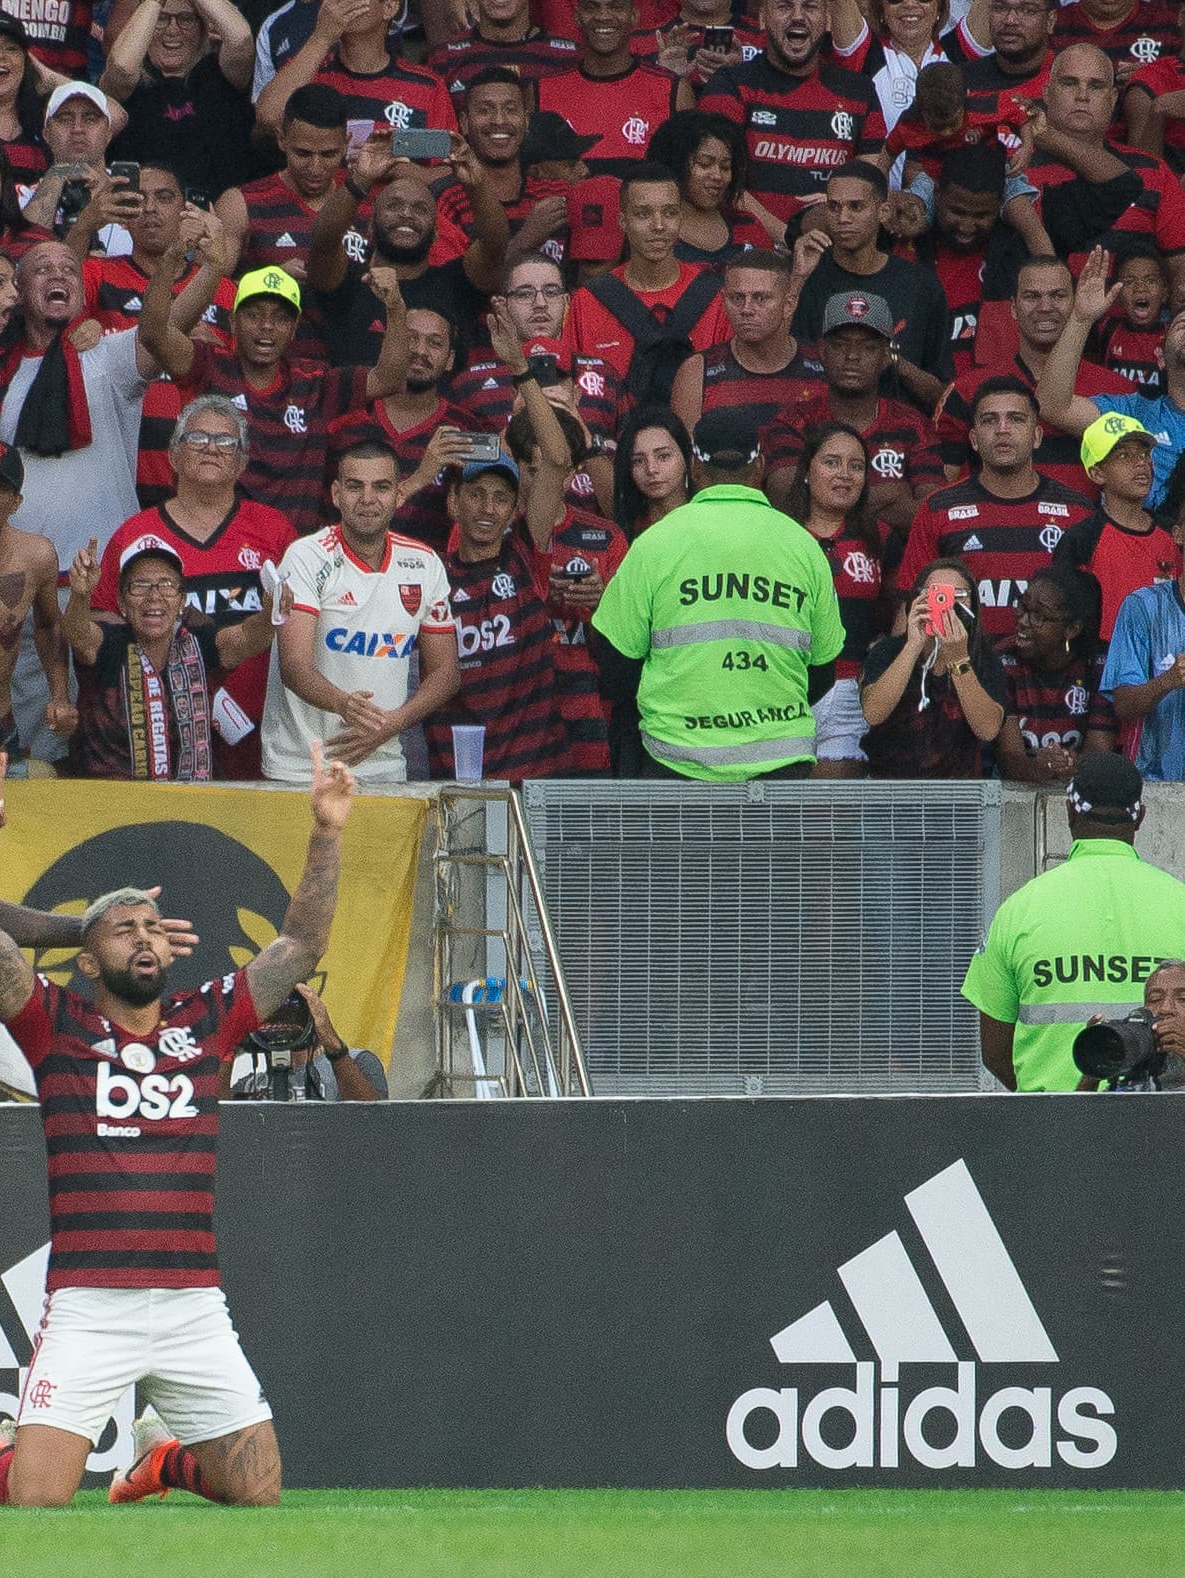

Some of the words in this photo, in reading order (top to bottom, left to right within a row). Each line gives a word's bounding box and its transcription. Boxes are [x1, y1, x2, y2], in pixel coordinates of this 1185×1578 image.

[754, 141, 848, 165] OLYMPIKUS
[184, 586, 264, 614] AIXA
[679, 572, 809, 614] SUNSET
[454, 614, 516, 658] bs2
[722, 651, 769, 671] 434
[150, 701, 169, 775] REGATAS
[96, 1061, 200, 1120] bs2
[96, 1123, 141, 1137] Banco
[725, 1361, 1118, 1470] adidas
